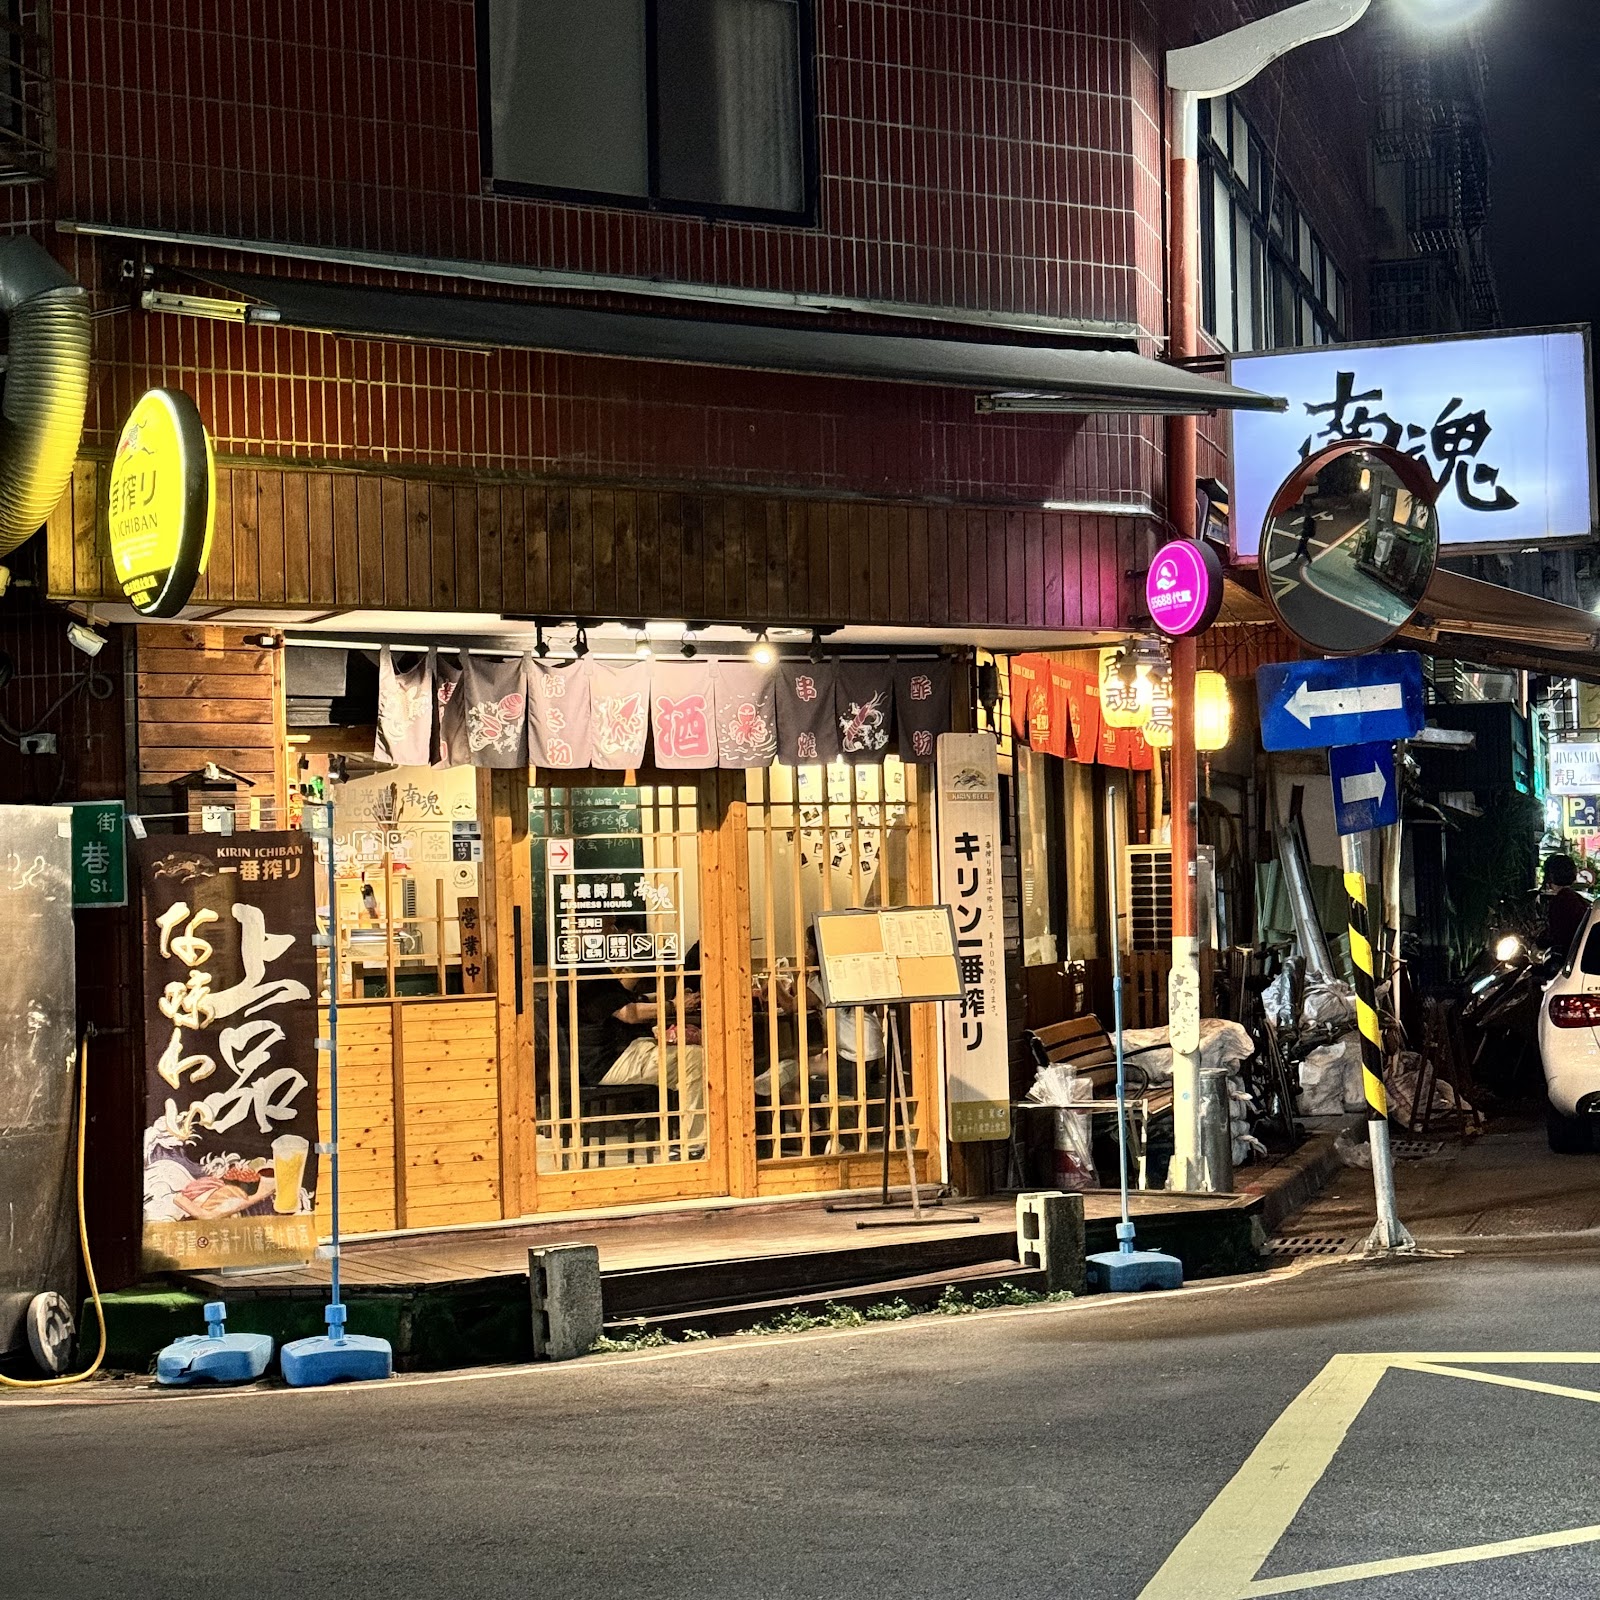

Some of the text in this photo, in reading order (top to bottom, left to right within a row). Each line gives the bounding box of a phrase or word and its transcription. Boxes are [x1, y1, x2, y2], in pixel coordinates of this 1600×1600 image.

[654, 694, 710, 758] 酒
[97, 812, 116, 833] 街
[81, 841, 110, 874] 巷
[217, 845, 303, 858] KIRIN ICHIBAN
[218, 858, 301, 881] 一番搾り
[90, 878, 113, 893] St.
[560, 900, 633, 909] BUSINESS HOURS
[955, 831, 986, 1052] キリン一番搾り
